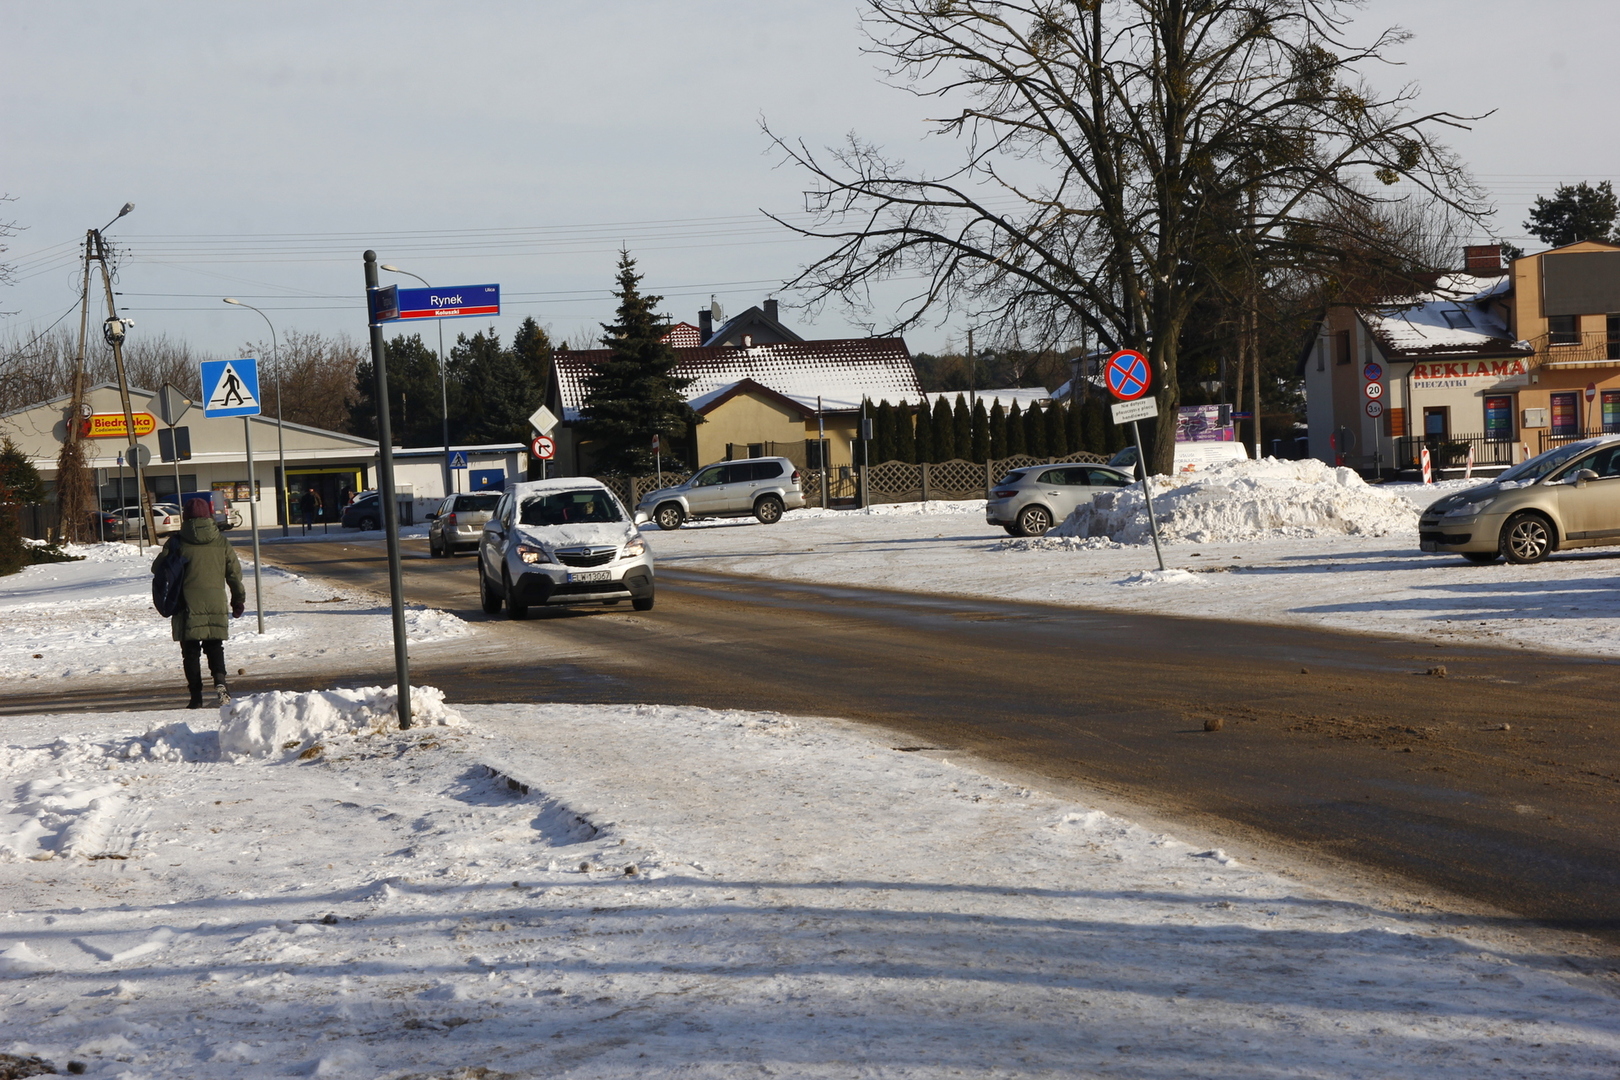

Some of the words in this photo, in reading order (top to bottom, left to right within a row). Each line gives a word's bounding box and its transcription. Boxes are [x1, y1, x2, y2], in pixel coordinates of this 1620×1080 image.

[430, 294, 463, 308] Rynek
[1413, 359, 1527, 380] REKLAMA
[1414, 380, 1467, 389] PIECZĄTKI
[1368, 386, 1380, 395] 20
[572, 573, 586, 582] ELW
